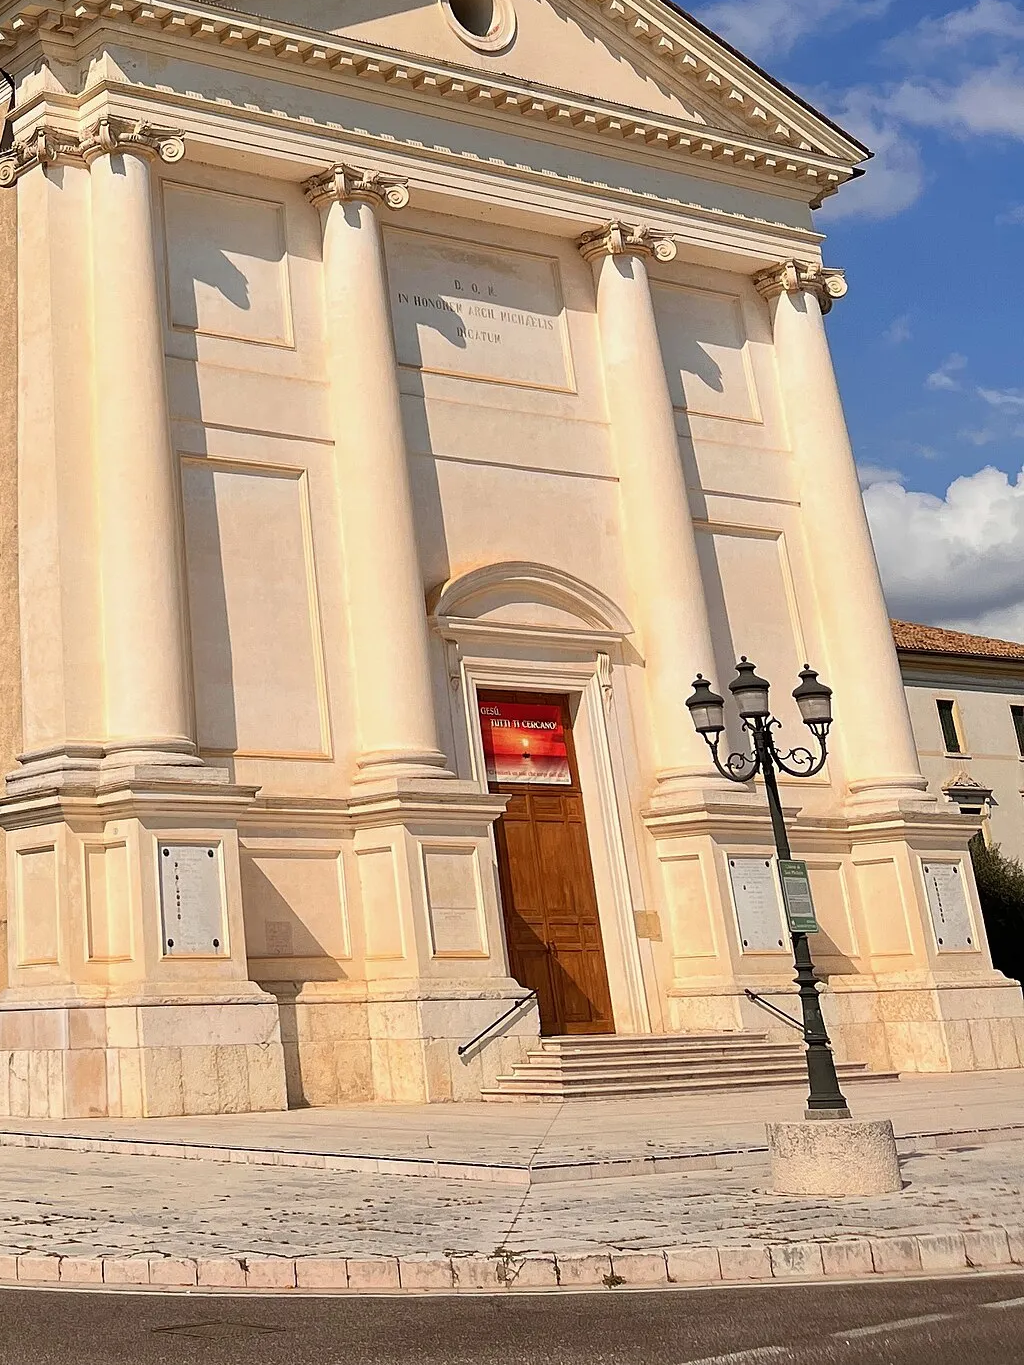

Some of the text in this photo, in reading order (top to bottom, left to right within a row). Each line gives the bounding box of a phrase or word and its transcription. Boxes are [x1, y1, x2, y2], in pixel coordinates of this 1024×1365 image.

[454, 280, 464, 292] D.
[471, 283, 481, 295] O.
[398, 293, 410, 304] IN
[414, 296, 462, 313] HONOREM
[457, 327, 502, 344] DICATUM
[490, 718, 557, 730] TUTTI TI CERCANO!
